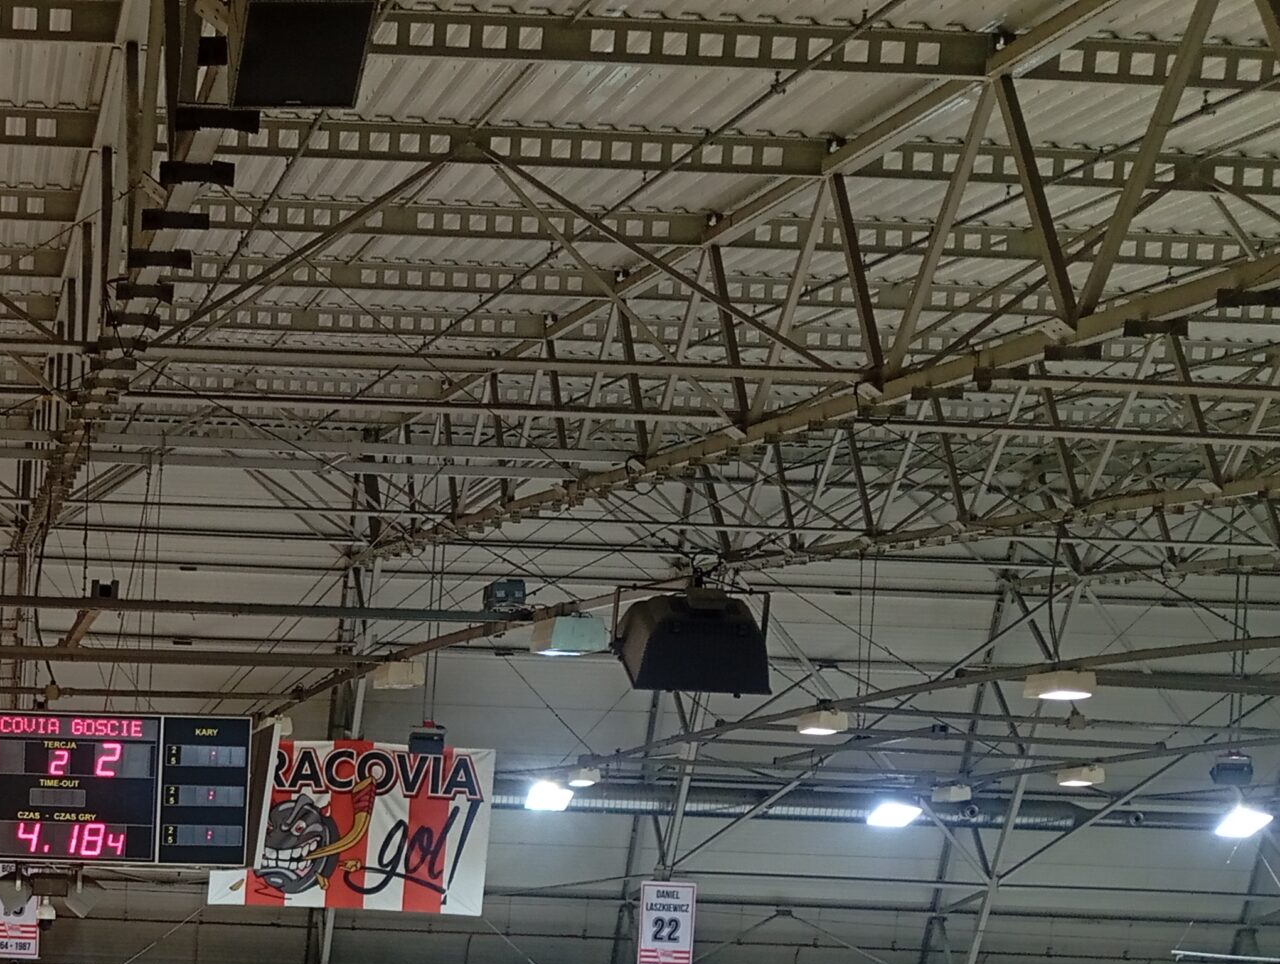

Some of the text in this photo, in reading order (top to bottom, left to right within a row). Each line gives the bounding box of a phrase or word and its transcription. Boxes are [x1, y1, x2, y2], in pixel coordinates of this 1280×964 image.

[71, 719, 143, 737] GOSCIE
[195, 728, 219, 737] KARY
[44, 740, 77, 749] TERCJA
[49, 750, 69, 775] 2
[95, 743, 121, 777] 2
[273, 747, 481, 799] RACOVIA
[39, 778, 80, 788] TIME-OUT
[17, 811, 40, 820] CZAS
[53, 812, 77, 821] CZAS
[78, 813, 97, 822] GRY
[652, 916, 681, 943] 22
[15, 942, 31, 951] 1987
